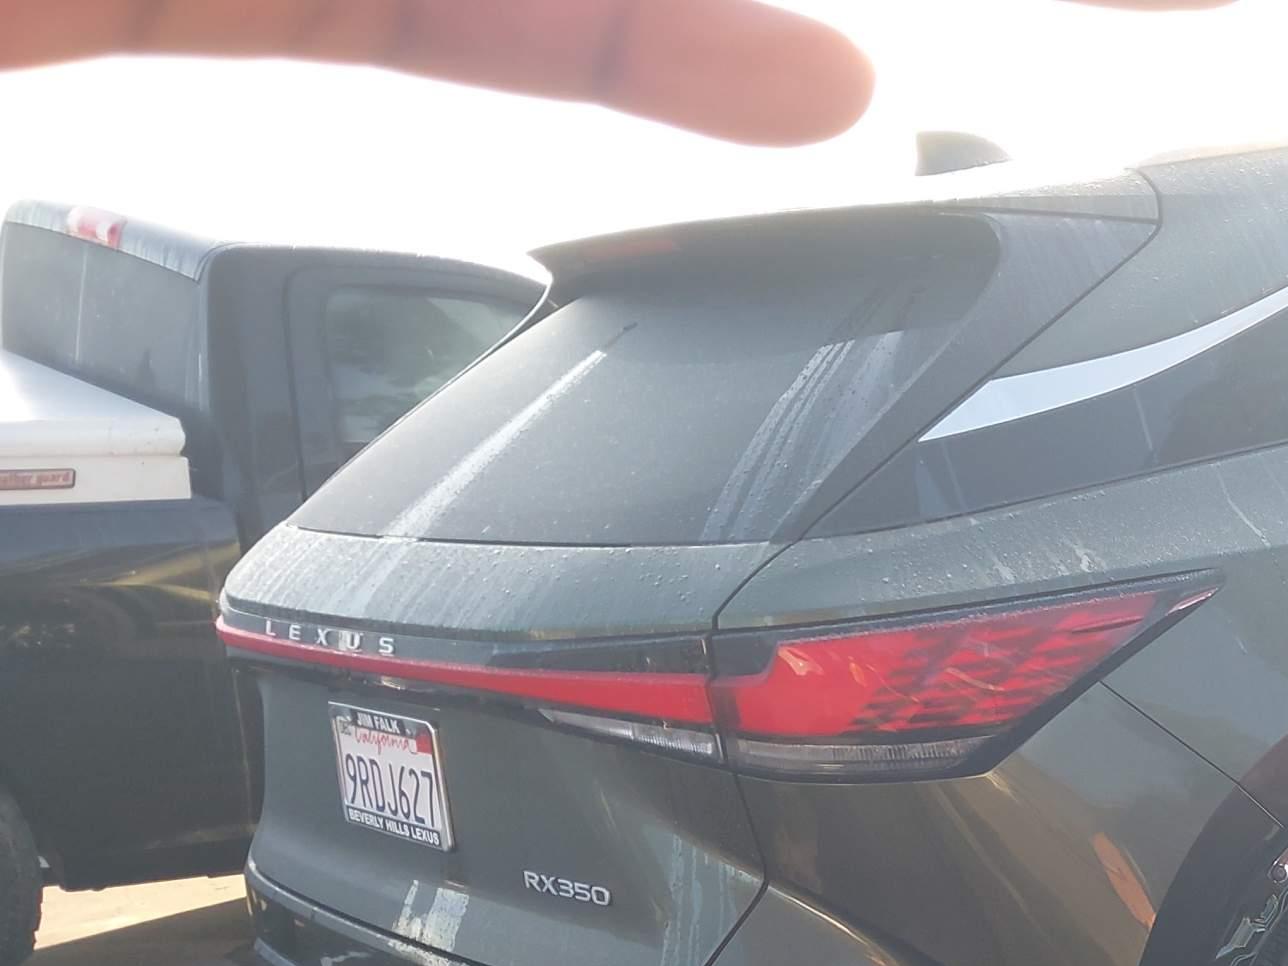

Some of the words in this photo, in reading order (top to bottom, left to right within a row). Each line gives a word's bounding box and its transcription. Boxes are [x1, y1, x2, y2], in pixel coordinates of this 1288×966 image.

[265, 619, 395, 655] LEXUS
[356, 711, 375, 729] JIM
[373, 714, 400, 733] FALK
[345, 753, 436, 828] 9RDJ627
[348, 807, 384, 831] BEVERLY
[384, 818, 410, 837] HILLS
[410, 825, 440, 846] LEXUS
[523, 870, 610, 906] RX350
